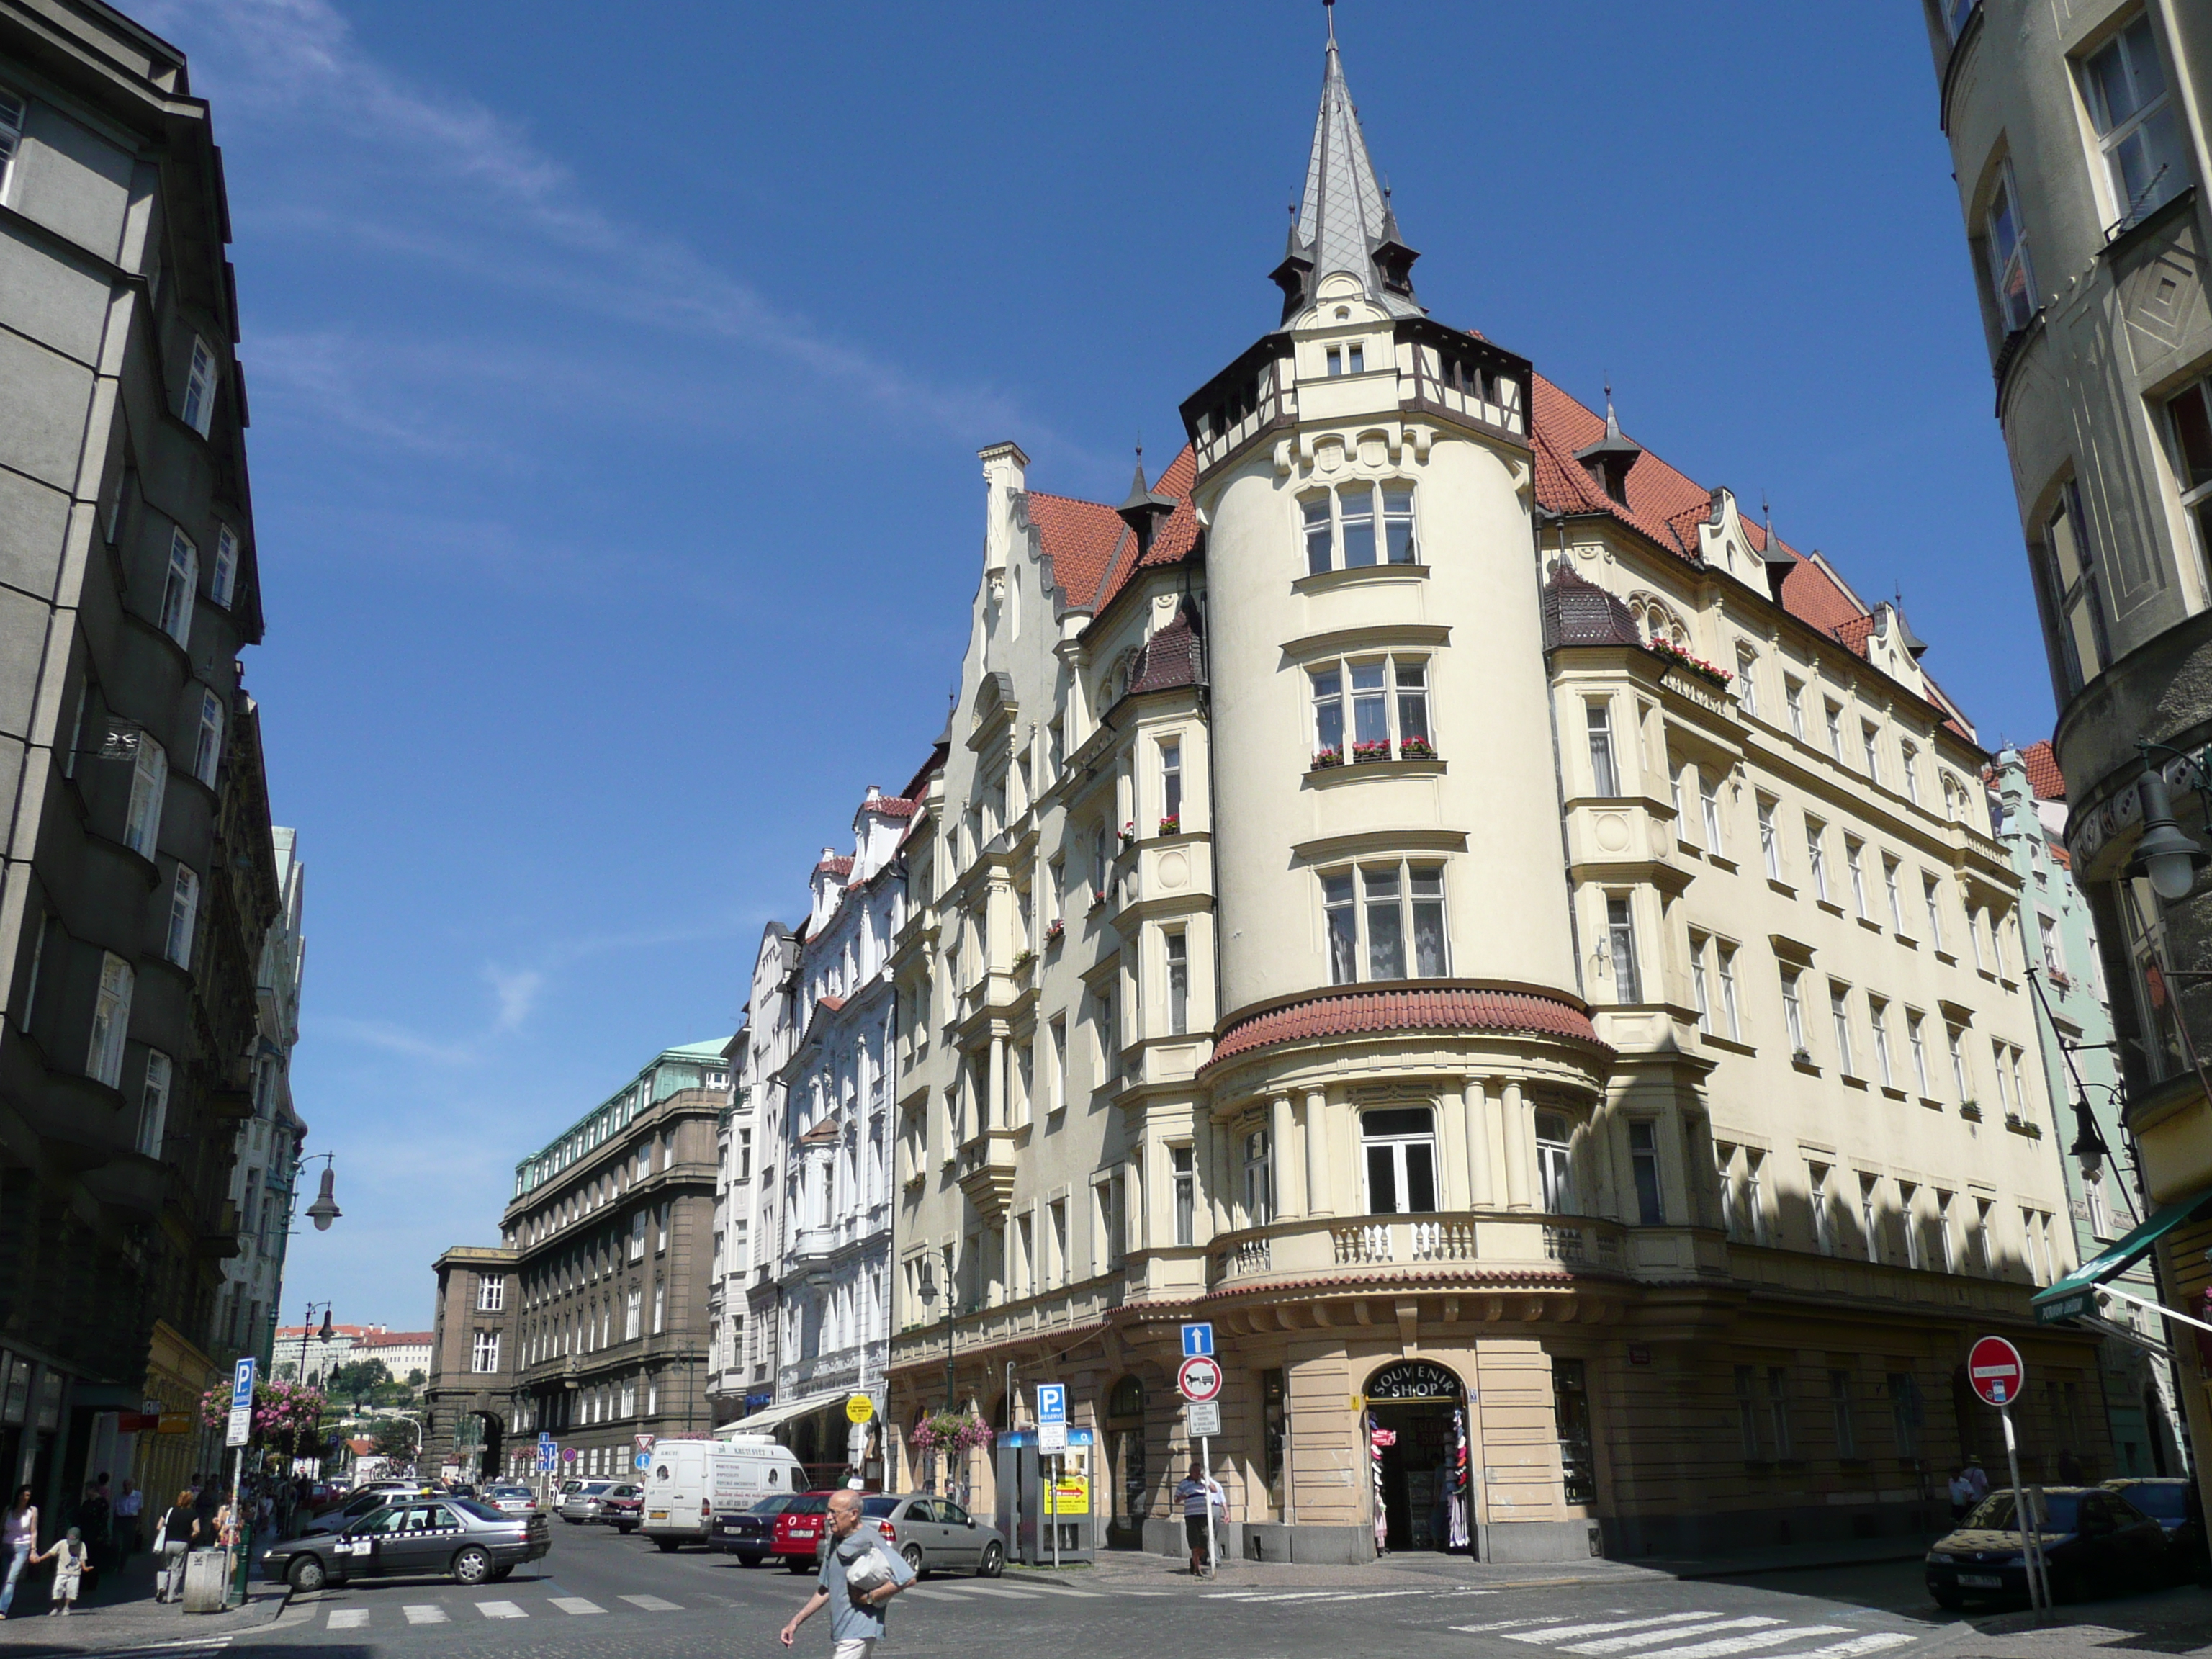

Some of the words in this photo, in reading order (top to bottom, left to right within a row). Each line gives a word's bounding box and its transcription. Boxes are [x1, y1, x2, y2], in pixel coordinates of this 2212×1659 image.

[237, 1365, 250, 1393] P
[1374, 1366, 1455, 1395] SOUVENIR
[1392, 1382, 1439, 1397] SHOP
[1043, 1389, 1059, 1413] P
